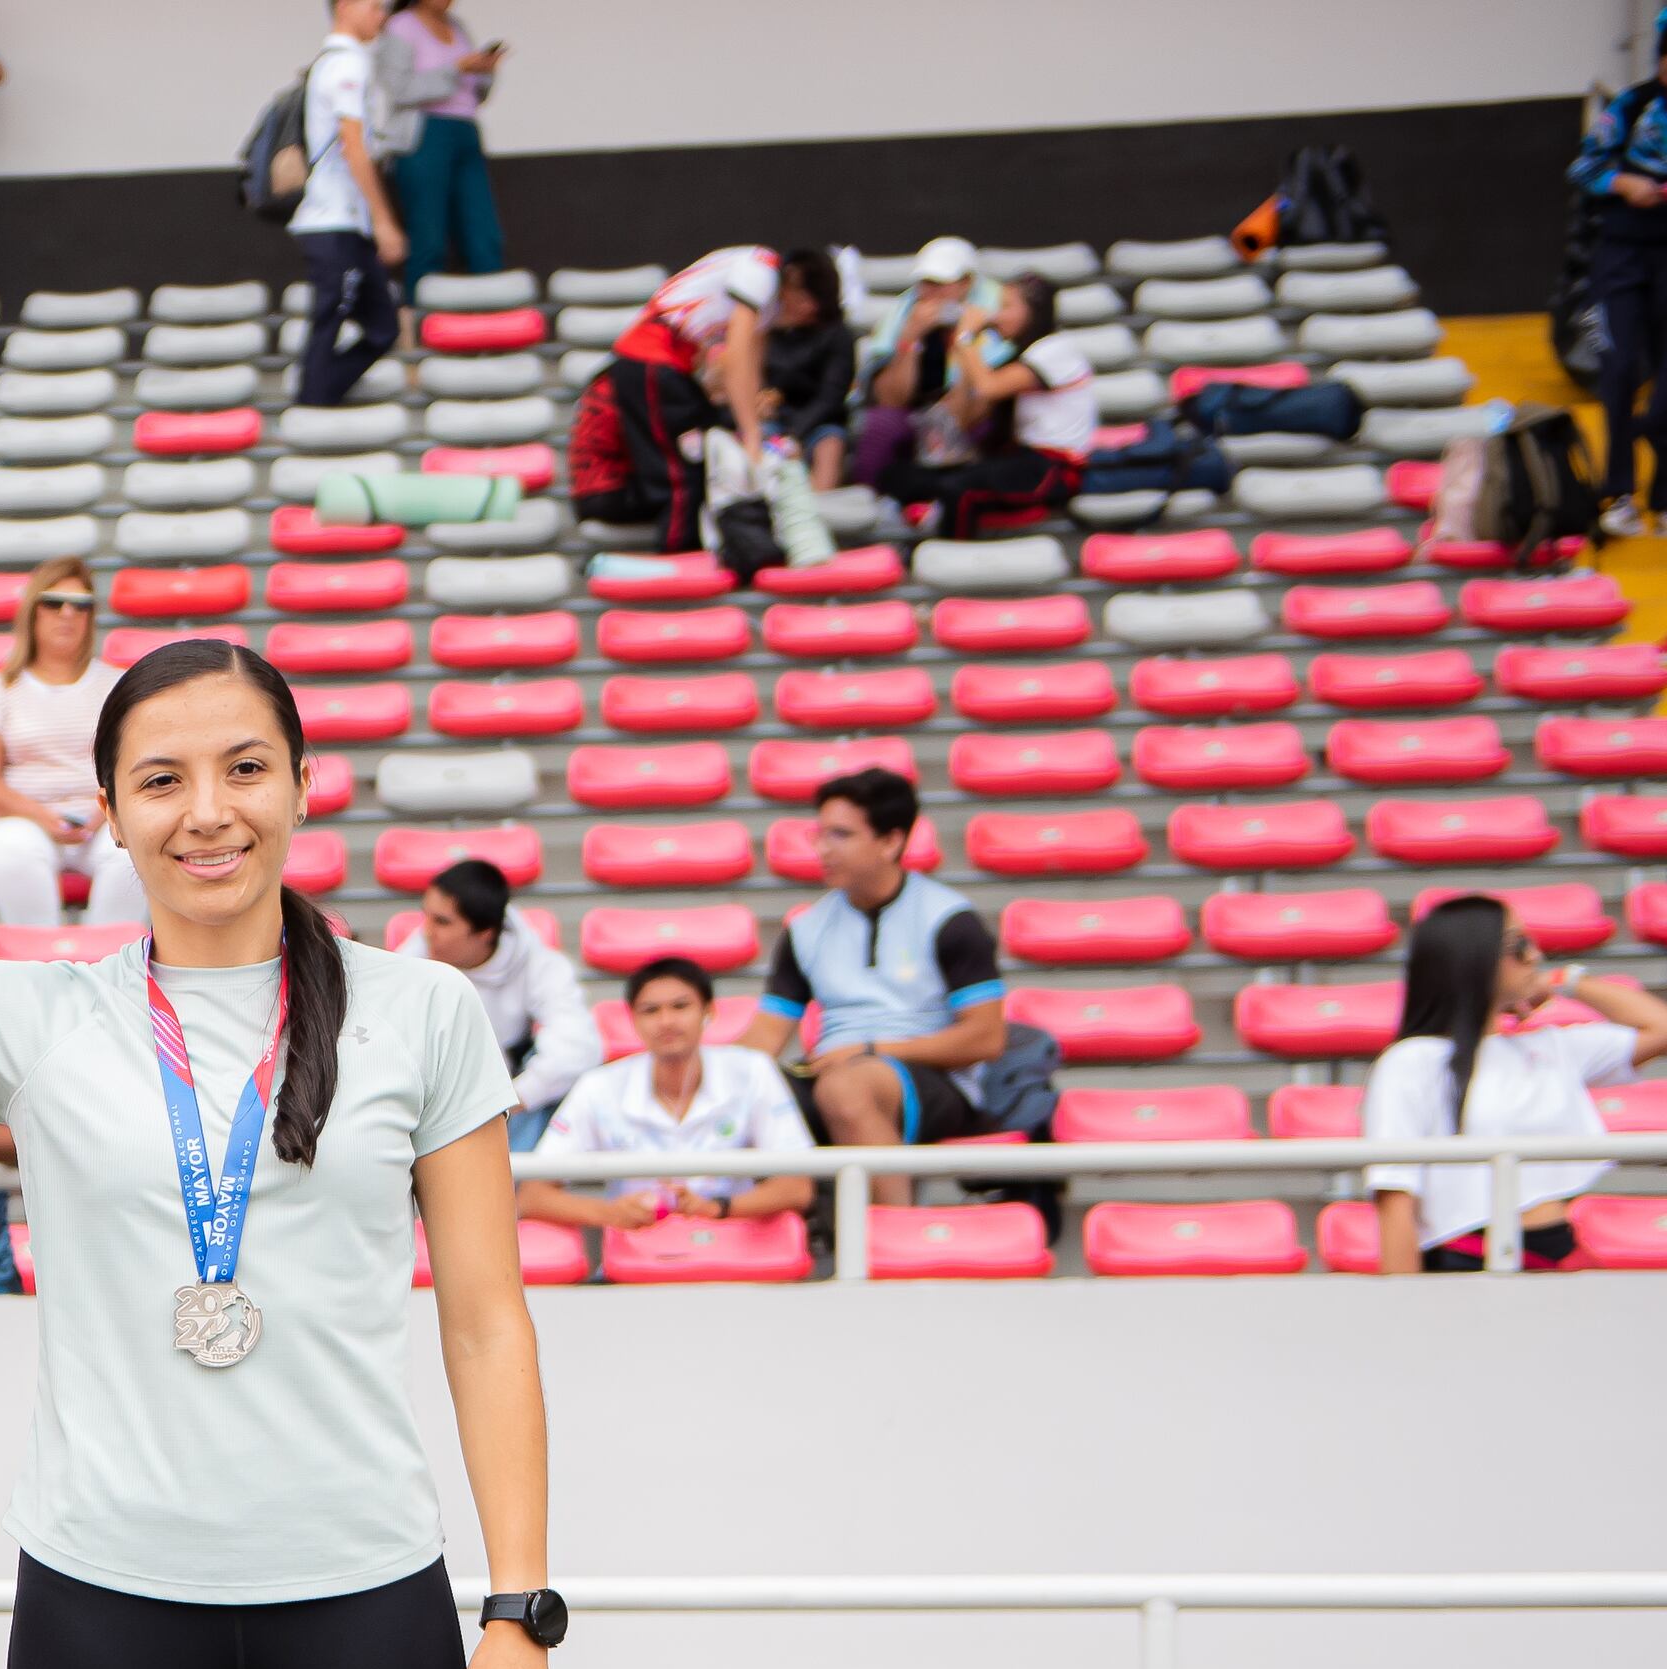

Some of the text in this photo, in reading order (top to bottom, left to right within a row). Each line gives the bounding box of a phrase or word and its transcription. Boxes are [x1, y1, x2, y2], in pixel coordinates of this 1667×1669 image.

[171, 1104, 205, 1263] CAMPEONATO NACIONAL
[186, 1137, 211, 1208] MAYOR
[210, 1176, 237, 1248] MAYOR
[220, 1139, 252, 1281] CAMPEONATO NACIO
[175, 1286, 221, 1318] 20
